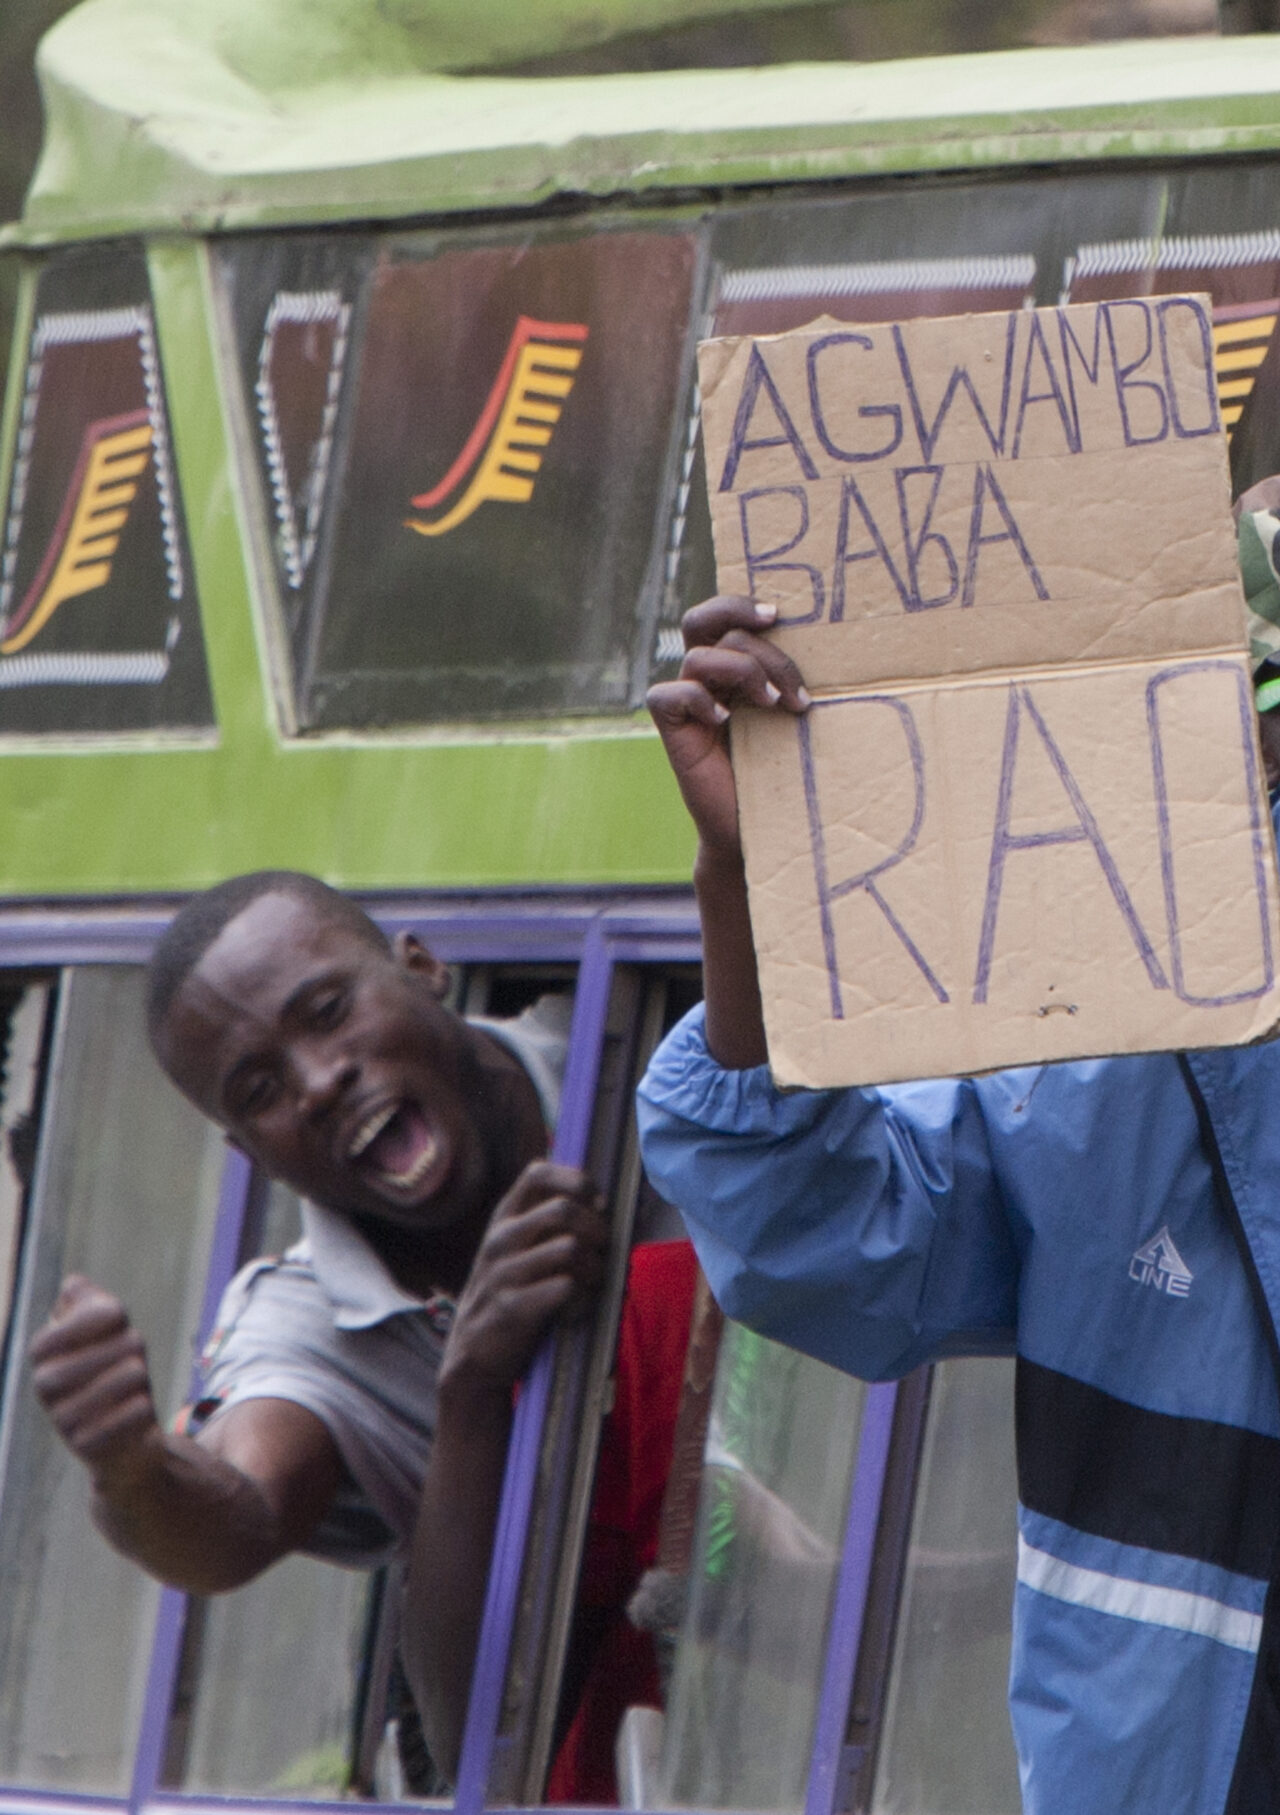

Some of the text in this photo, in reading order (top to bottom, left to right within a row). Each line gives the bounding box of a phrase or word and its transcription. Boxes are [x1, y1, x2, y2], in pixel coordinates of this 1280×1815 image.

[717, 297, 1221, 492] AGWAMBO
[739, 461, 1051, 627] BABA
[801, 660, 1275, 1021] RAO
